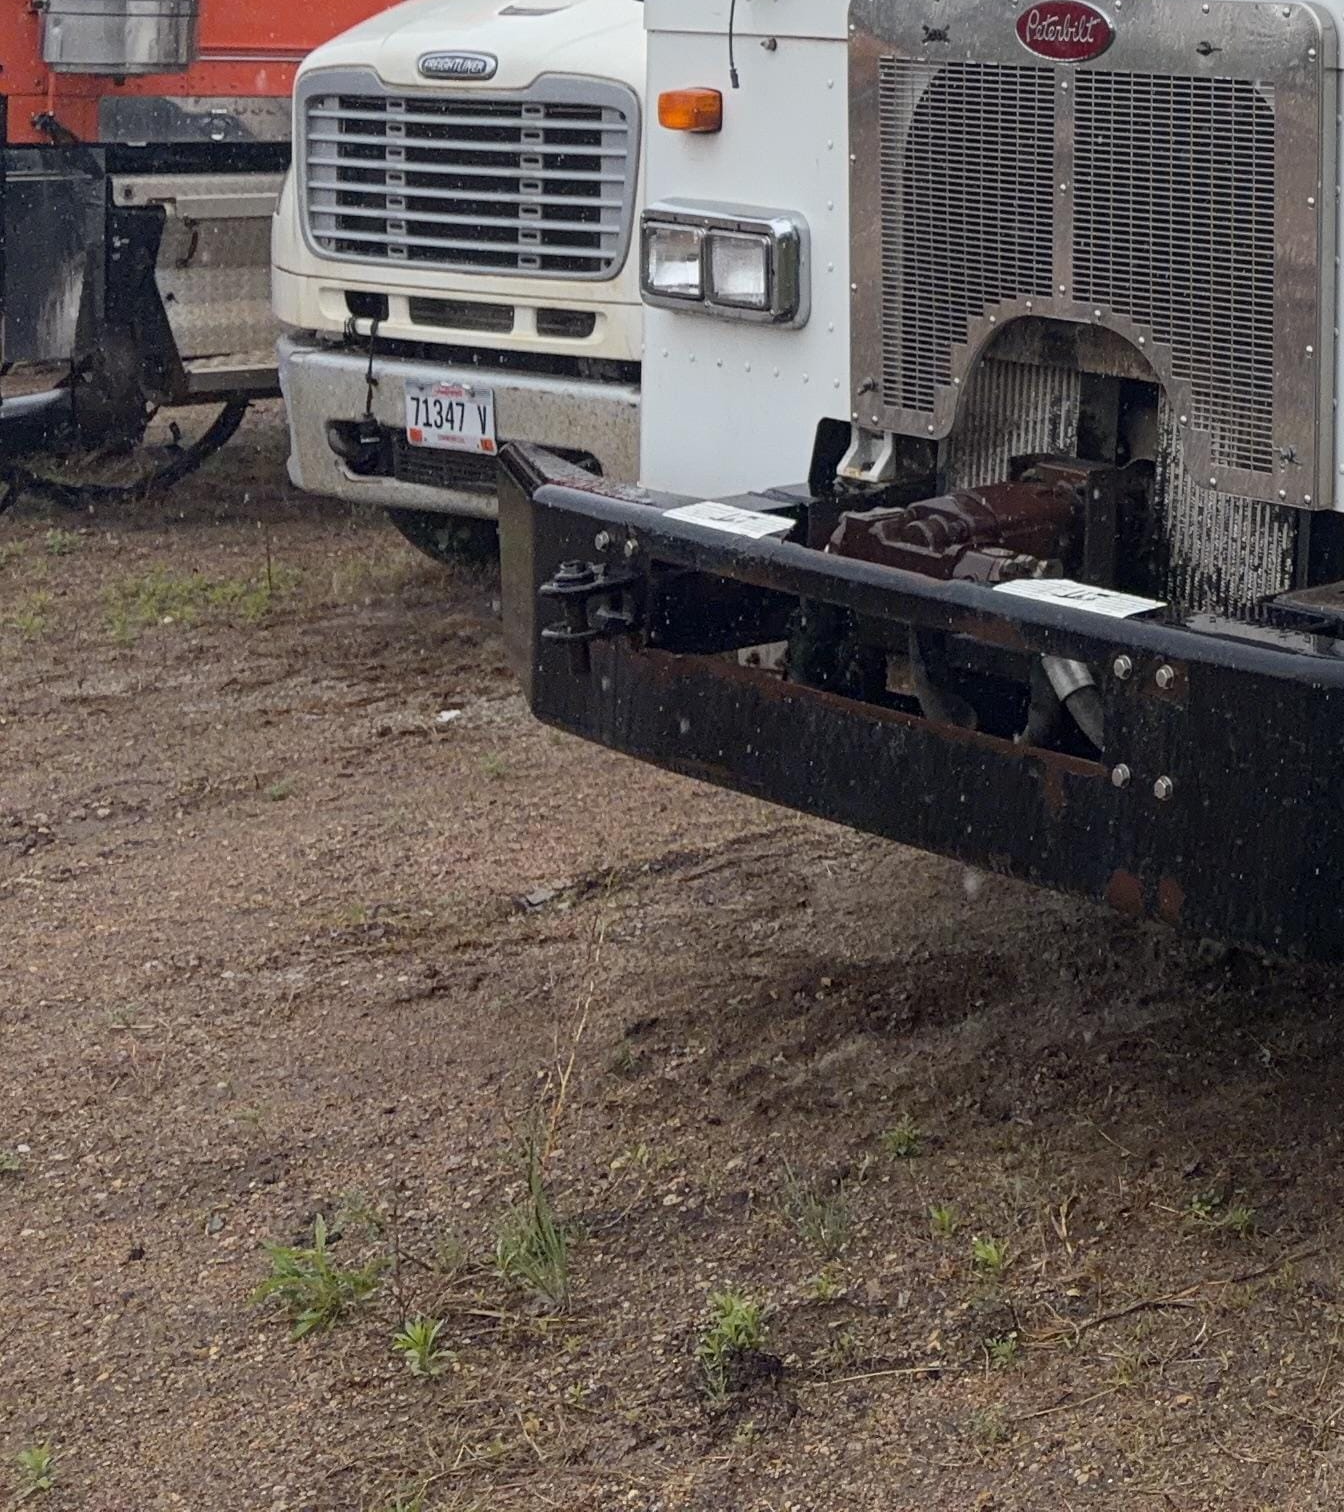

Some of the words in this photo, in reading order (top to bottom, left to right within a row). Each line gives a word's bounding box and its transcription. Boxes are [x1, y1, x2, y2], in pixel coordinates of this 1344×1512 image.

[1025, 9, 1102, 43] Peterbilt
[410, 395, 465, 433] 71347
[477, 404, 487, 436] V
